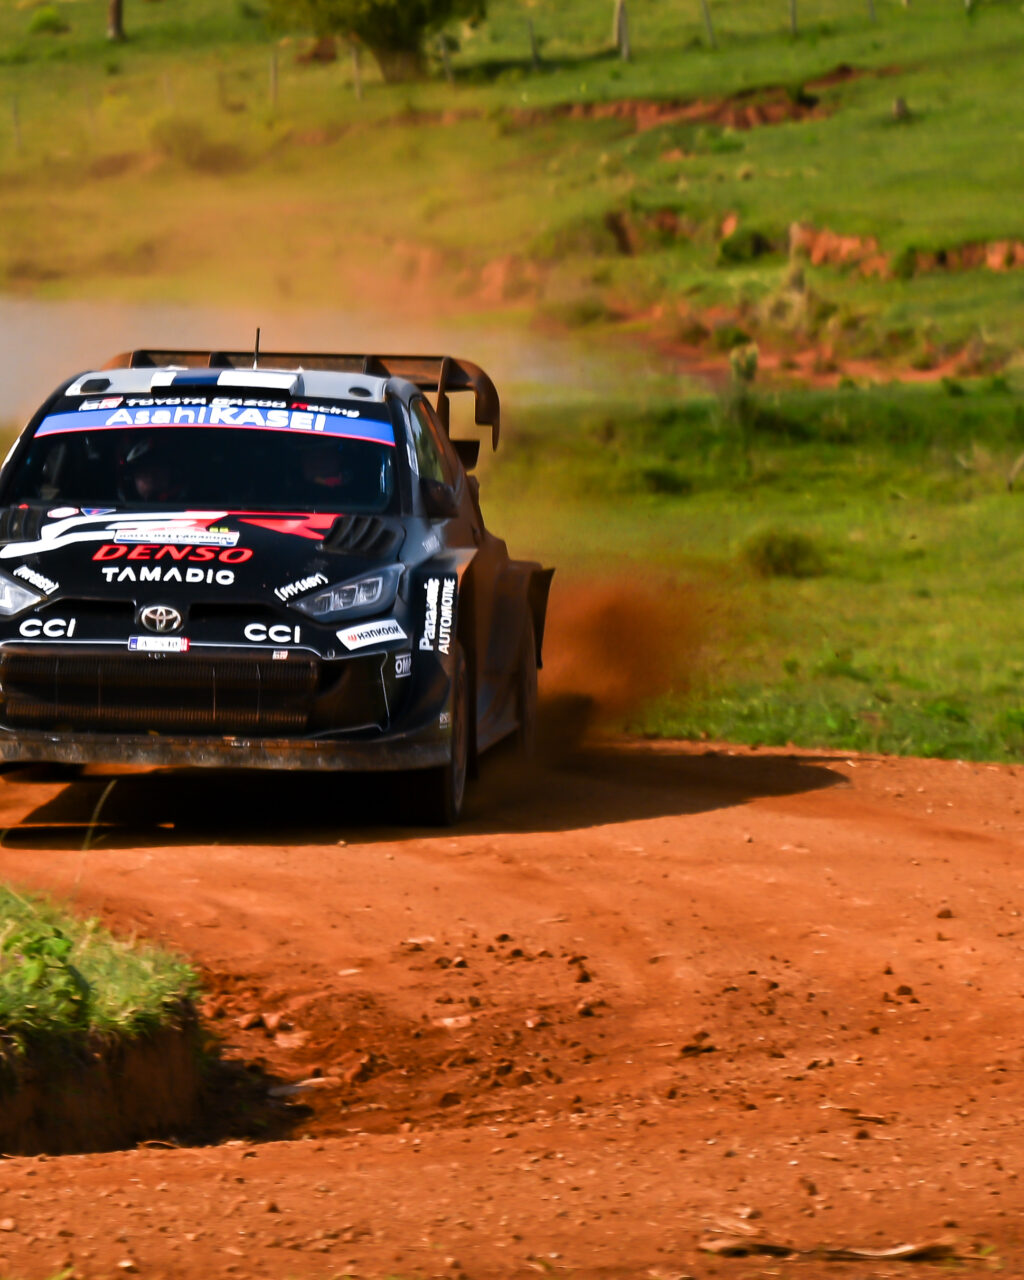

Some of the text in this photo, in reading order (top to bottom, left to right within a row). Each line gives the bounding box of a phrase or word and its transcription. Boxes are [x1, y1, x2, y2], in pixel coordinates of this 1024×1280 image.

[92, 544, 253, 564] DENSO
[437, 577, 456, 655] AUTOMOTIVE
[19, 618, 76, 637] CCI
[244, 623, 301, 644] CCI
